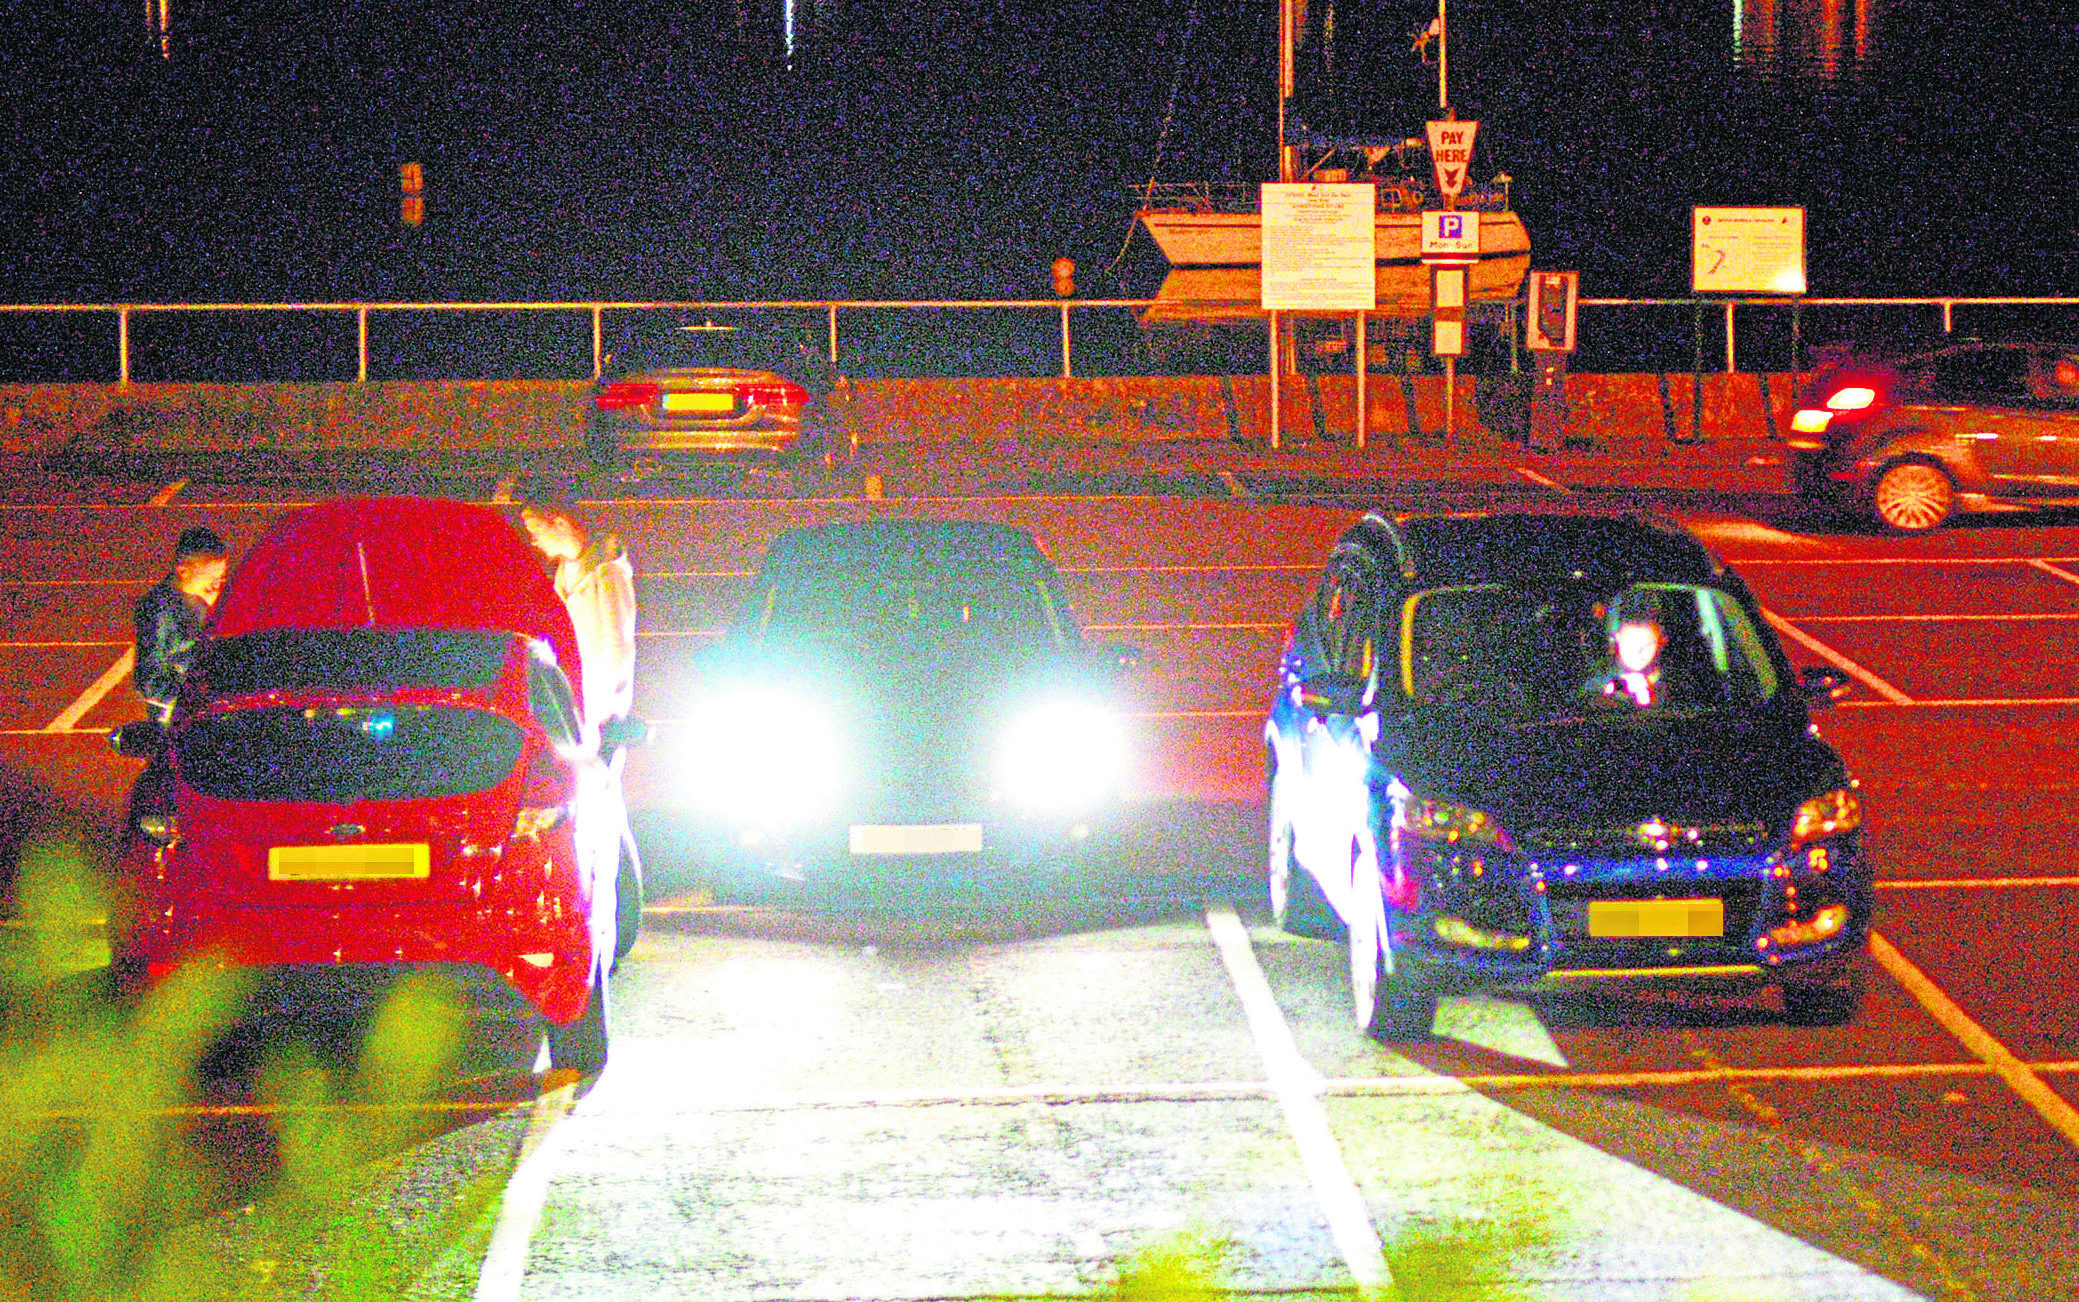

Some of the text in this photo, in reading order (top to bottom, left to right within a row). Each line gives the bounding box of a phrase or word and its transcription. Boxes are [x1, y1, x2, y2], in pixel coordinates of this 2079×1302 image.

[1441, 130, 1464, 145] PAY
[1436, 148, 1468, 163] HERE
[1444, 217, 1459, 237] P
